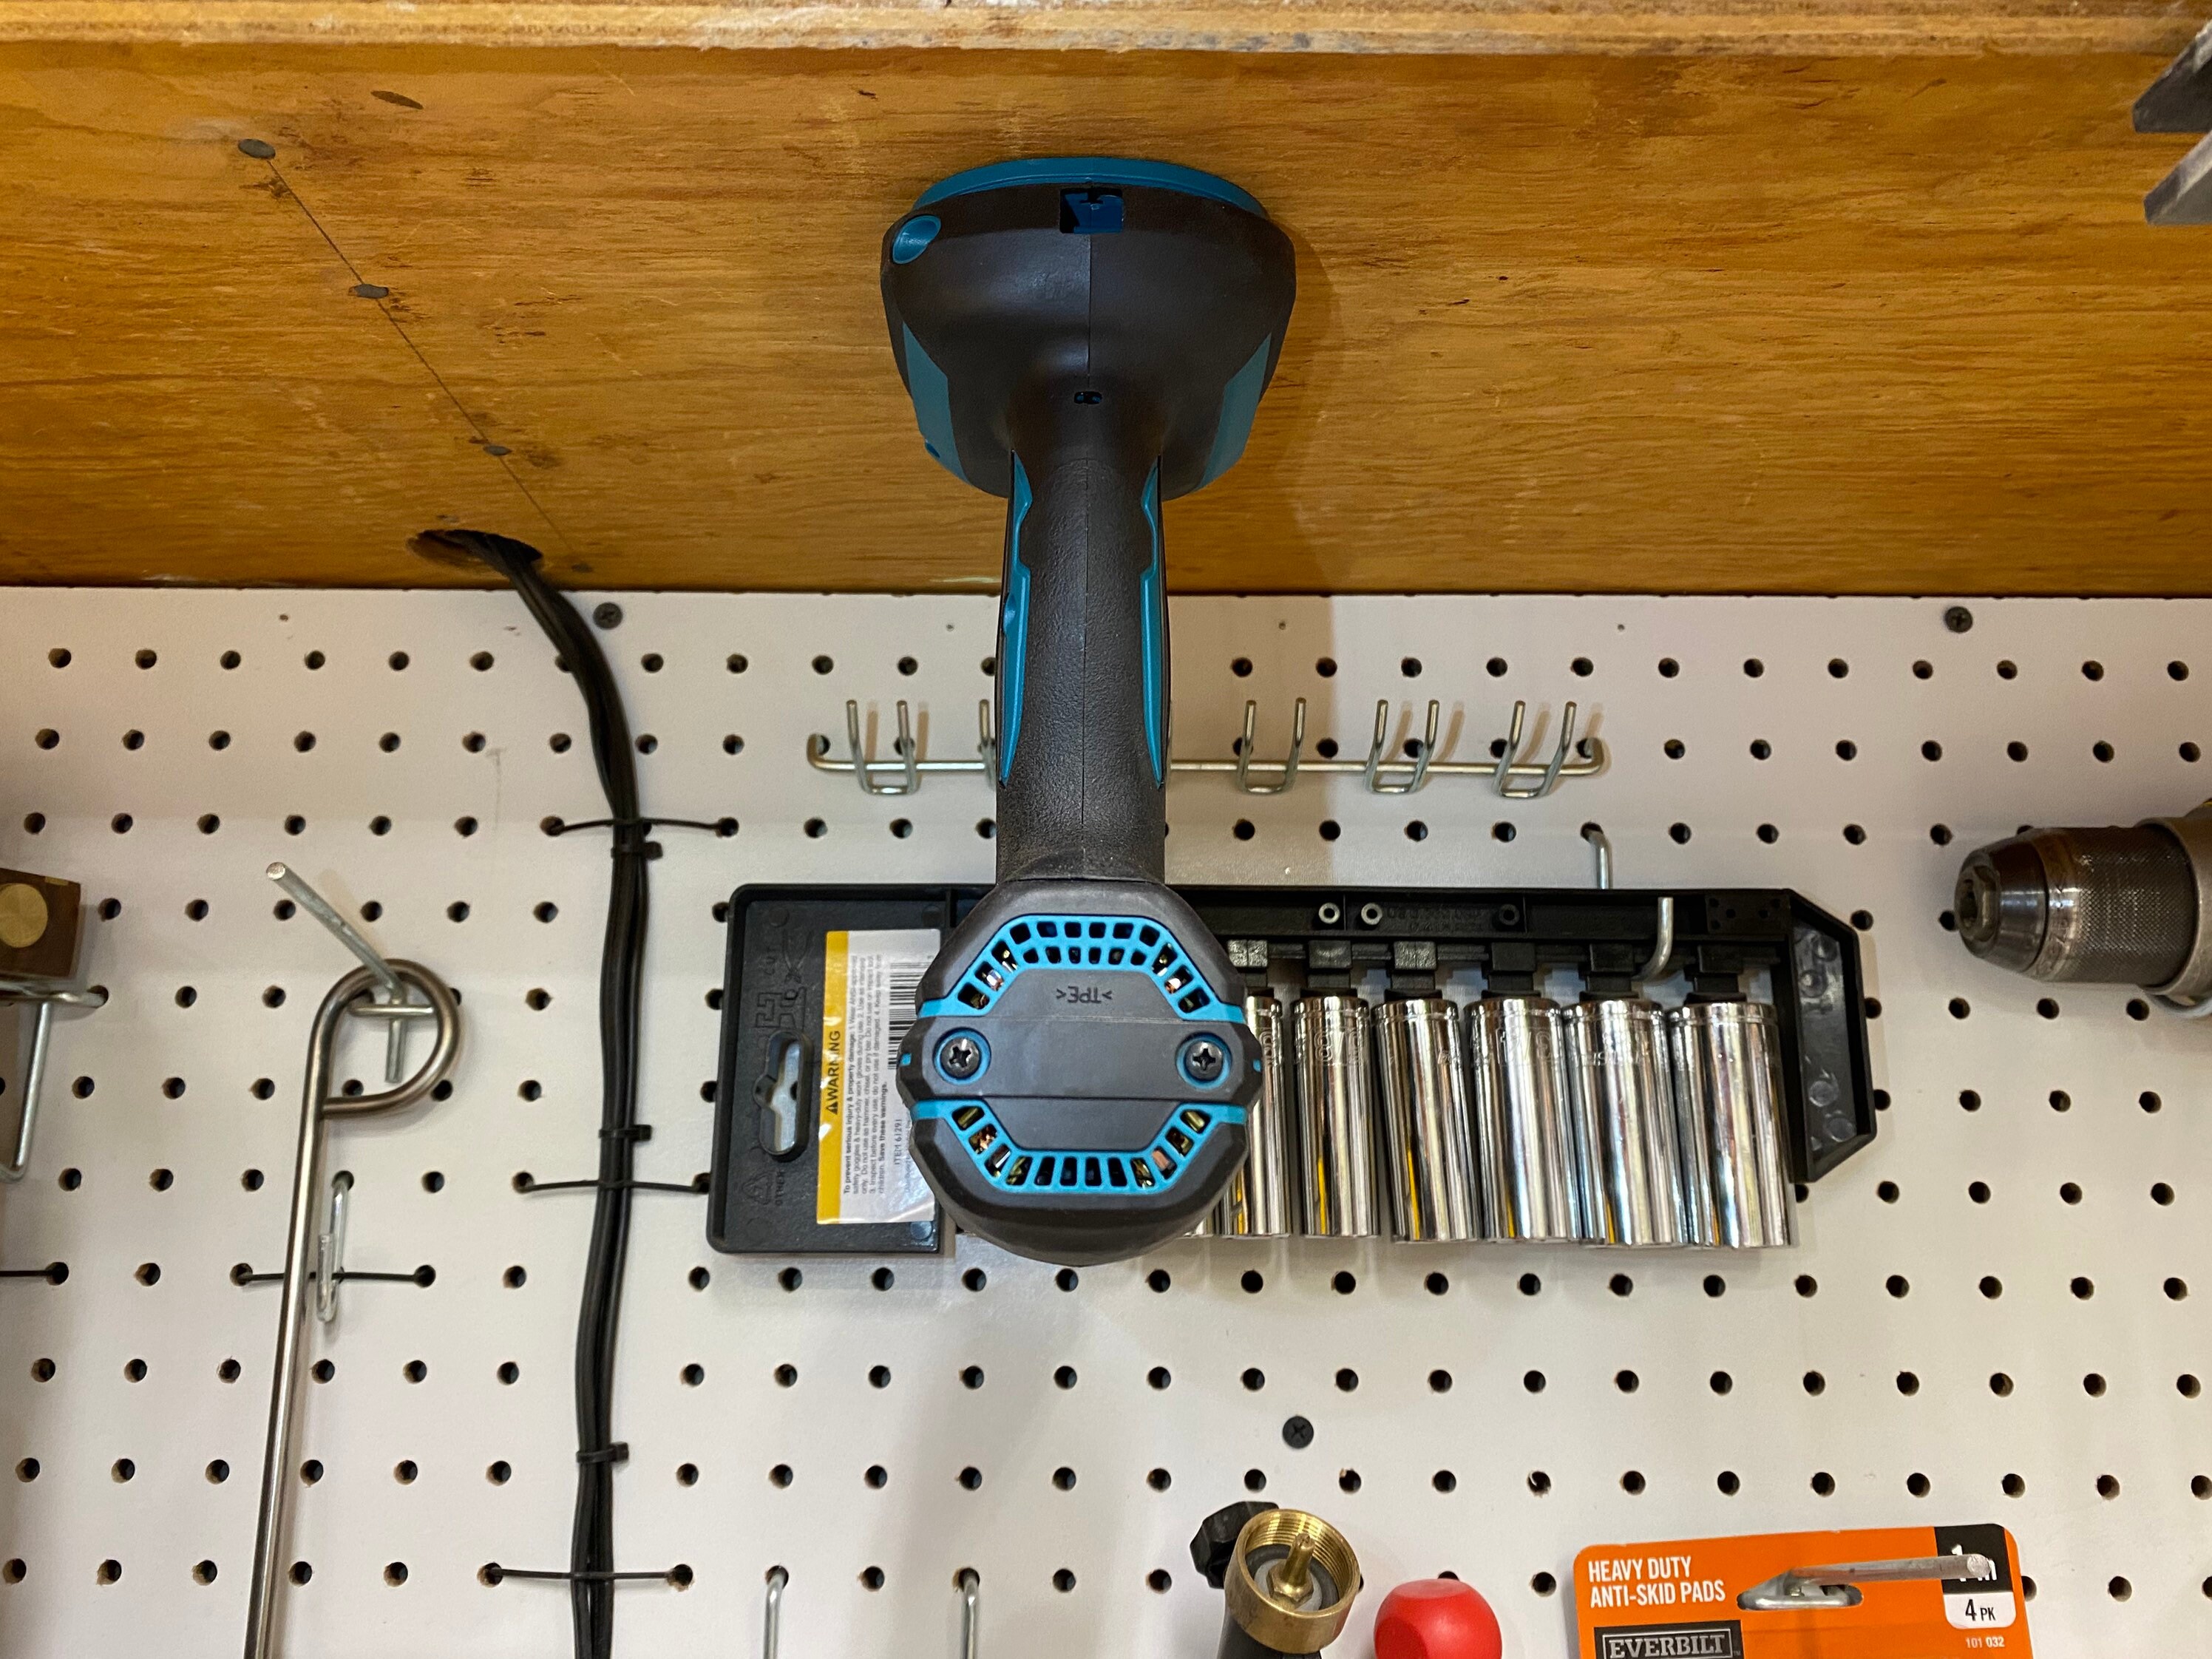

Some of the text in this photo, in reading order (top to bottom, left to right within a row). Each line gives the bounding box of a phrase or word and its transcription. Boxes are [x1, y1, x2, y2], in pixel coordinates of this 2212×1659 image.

[861, 1165, 867, 1175] Do
[865, 1028, 871, 1037] Do
[872, 1087, 878, 1095] do
[880, 1082, 888, 1118] warnings.
[846, 1104, 854, 1124] injury
[854, 1099, 862, 1135] heavy-duty
[894, 1119, 902, 1142] 61291
[869, 1160, 878, 1185] Inspect
[844, 1185, 850, 1193] To
[1588, 1555, 1692, 1583] HEAVY DUTY
[1590, 1578, 1726, 1609] ANTI-SKID PADS
[1965, 1598, 1996, 1621] 4 PK
[1608, 1635, 1725, 1659] EVERBILT
[1965, 1635, 2005, 1649] 101 032
